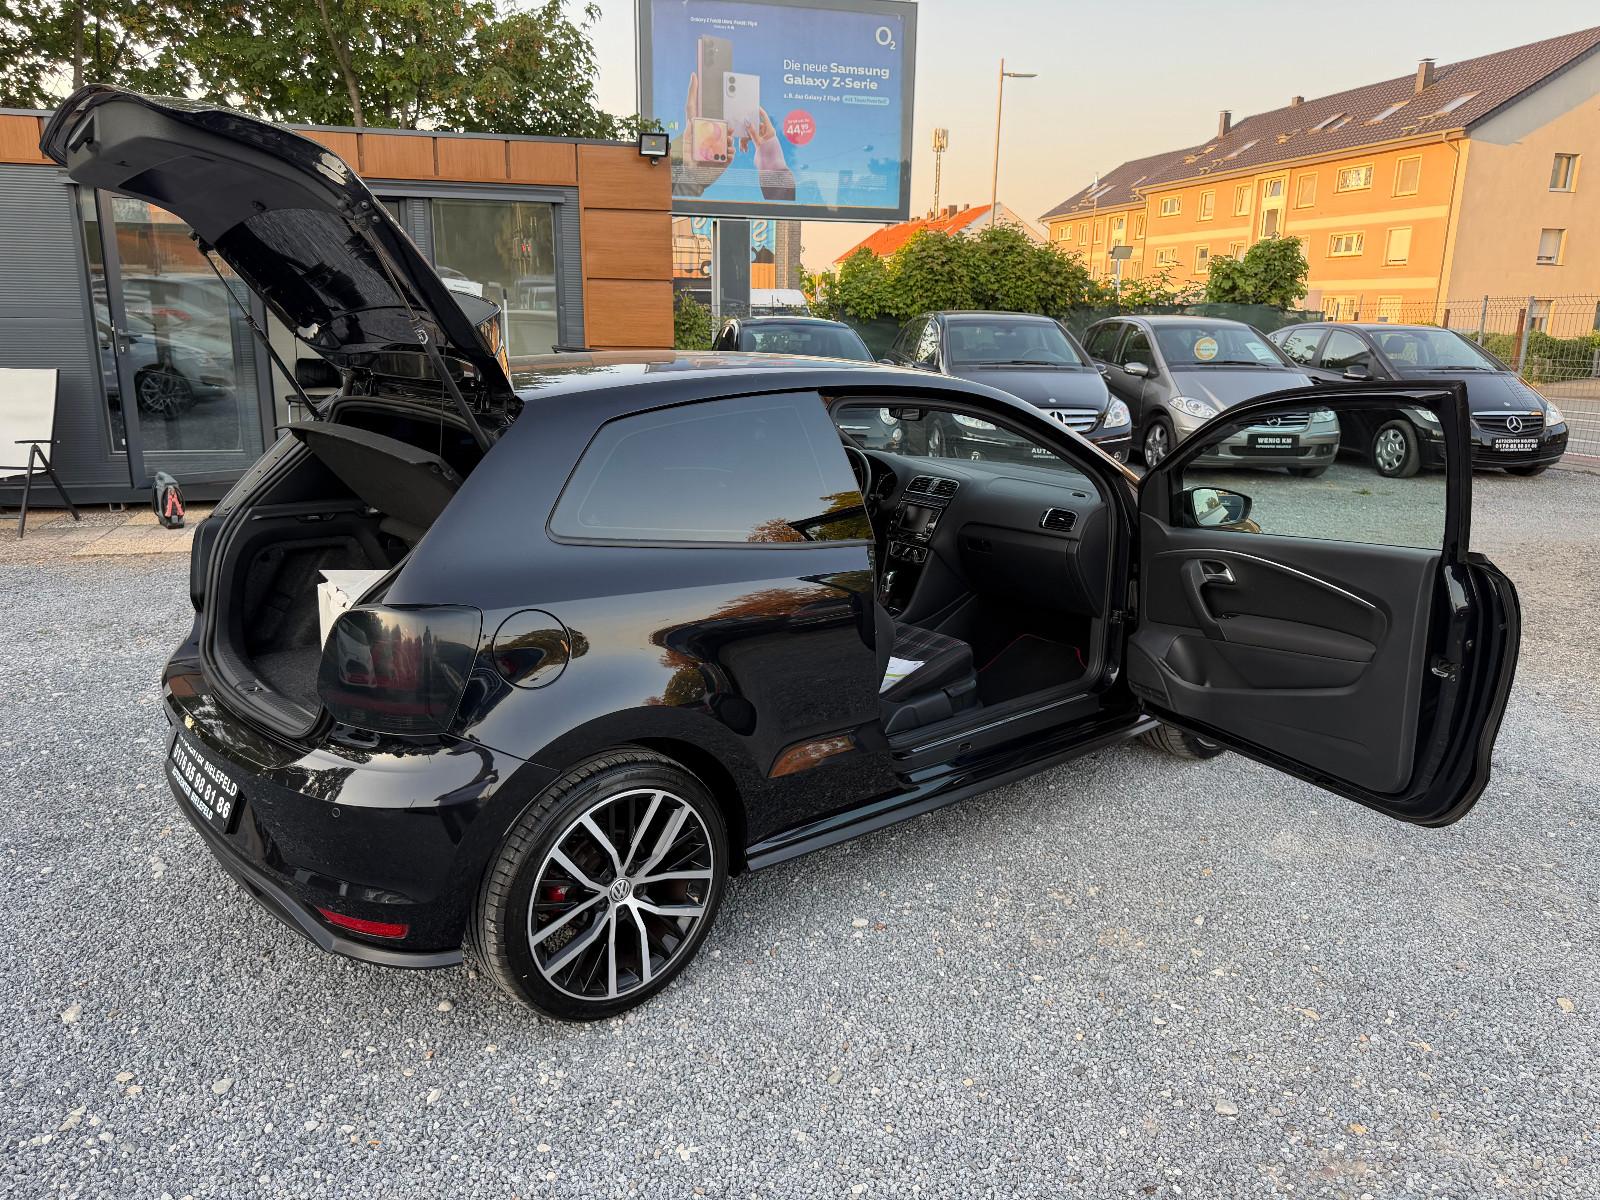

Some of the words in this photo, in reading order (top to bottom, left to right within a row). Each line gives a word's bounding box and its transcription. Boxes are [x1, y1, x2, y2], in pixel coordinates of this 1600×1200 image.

[783, 59, 800, 71] Die
[803, 63, 828, 73] neue
[830, 63, 890, 79] Samsung
[783, 74, 829, 89] Galaxy
[832, 77, 878, 90] Z-Serie
[185, 761, 196, 782] 85
[204, 783, 217, 806] 81
[216, 796, 231, 819] 86
[204, 760, 238, 797] BIELEFELD
